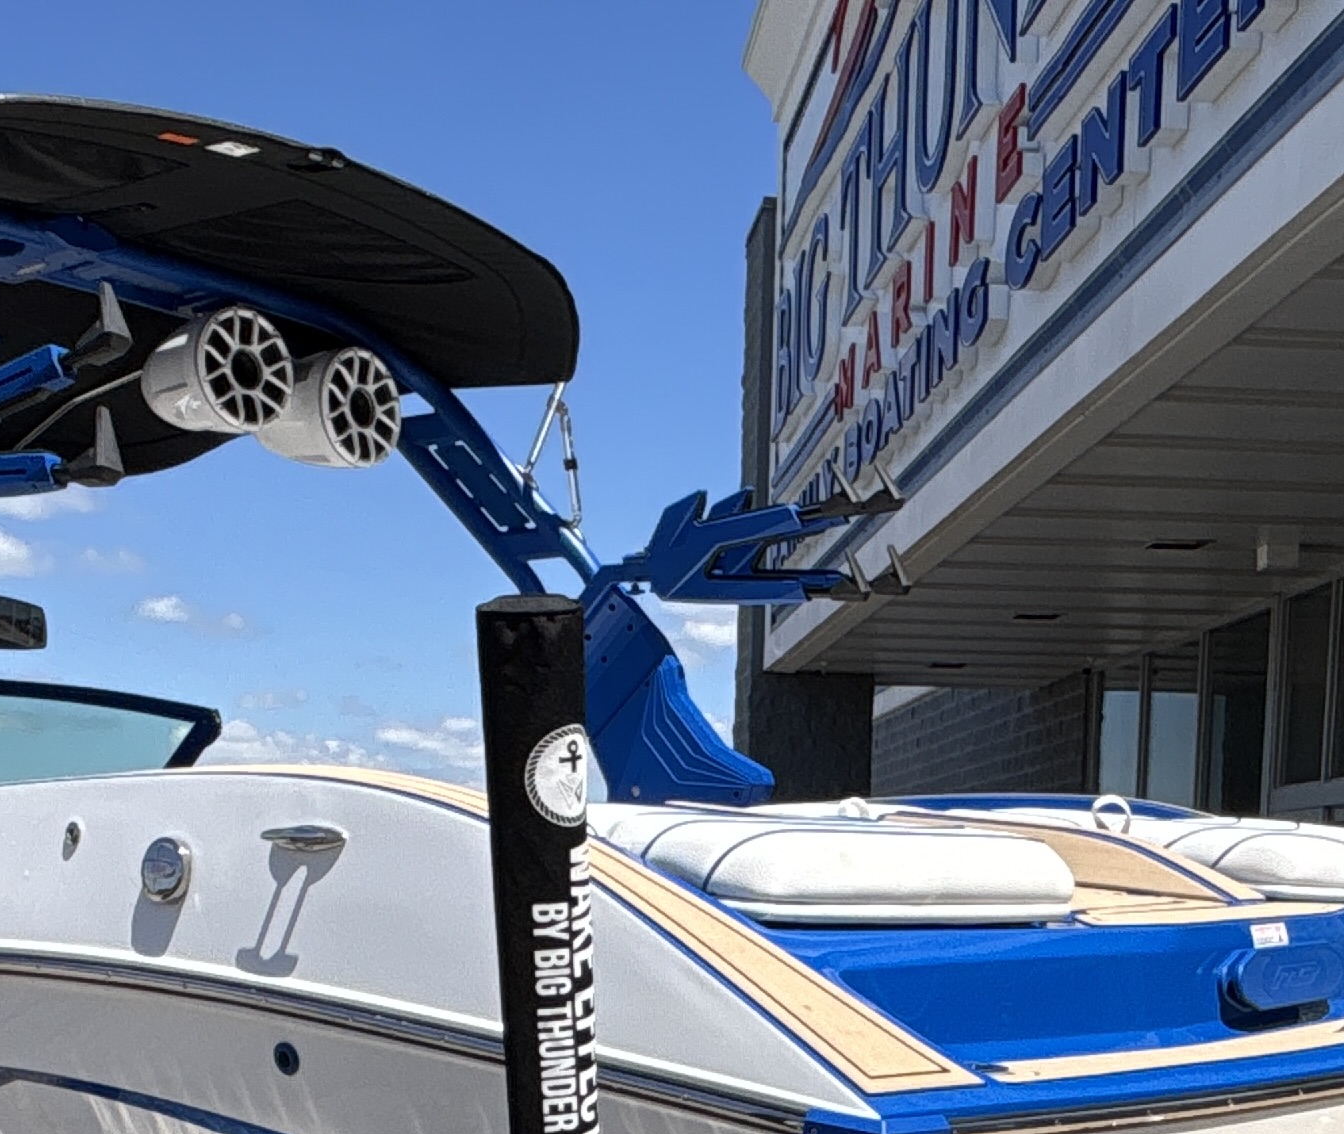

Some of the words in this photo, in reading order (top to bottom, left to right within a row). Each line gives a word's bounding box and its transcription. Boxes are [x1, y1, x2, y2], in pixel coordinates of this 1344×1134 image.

[771, 212, 832, 442] BIG
[833, 82, 1027, 423] MARINE
[843, 256, 991, 487] BOATING
[1005, 0, 1266, 290] CENTE
[532, 902, 570, 941] BY
[534, 948, 573, 997] BIG
[536, 1000, 580, 1134] THUNDER
